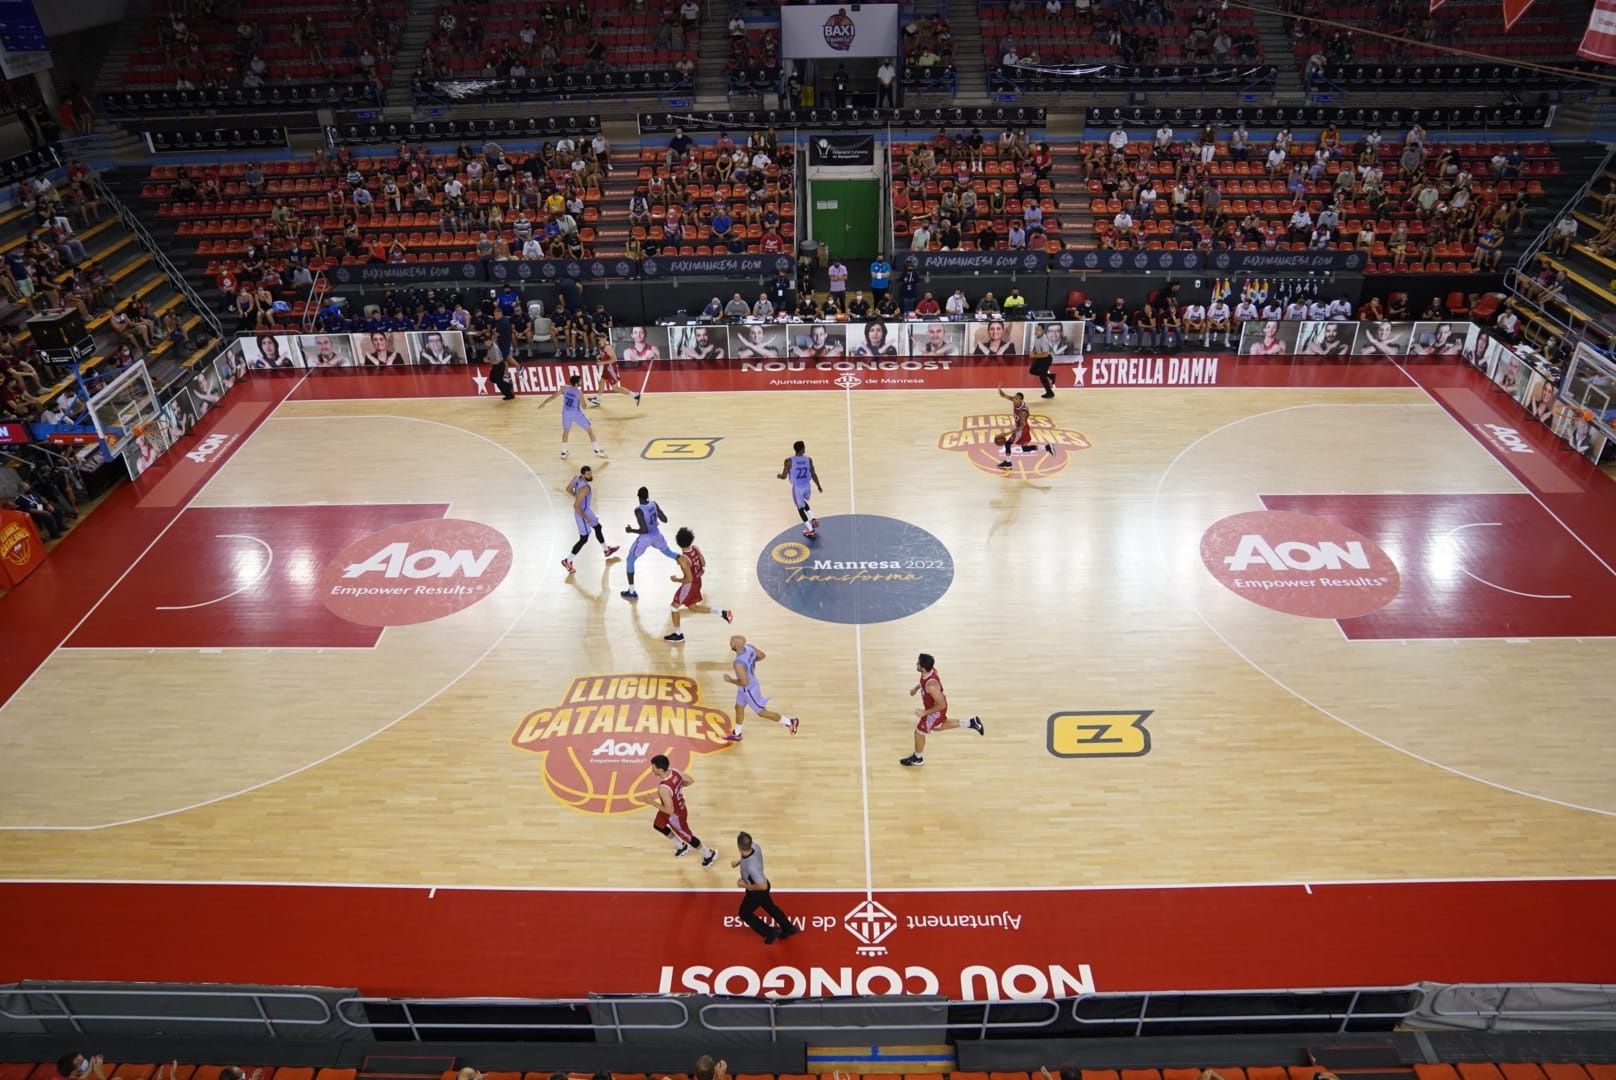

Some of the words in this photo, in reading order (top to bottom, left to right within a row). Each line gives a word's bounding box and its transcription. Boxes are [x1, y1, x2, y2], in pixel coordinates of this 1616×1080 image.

[825, 25, 854, 36] BAXI
[741, 361, 806, 372] NOU
[815, 360, 953, 371] CONGOST
[1091, 358, 1164, 385] ESTRELLA
[1167, 357, 1219, 385] DAMM
[494, 365, 566, 393] TRELLA
[769, 378, 830, 386] Ajuntament
[795, 467, 808, 479] 22
[341, 542, 499, 579] AON
[1223, 534, 1371, 572] AON
[813, 559, 902, 570] Manresa
[904, 560, 945, 569] 2022
[784, 566, 924, 585] Transforma
[1234, 578, 1316, 590] Empower
[330, 585, 411, 597] Empower
[568, 676, 694, 703] LLIGUES
[517, 704, 730, 745] CATALANES
[591, 738, 650, 756] AON
[811, 915, 837, 929] de
[906, 911, 1022, 930] Ajuntament
[960, 964, 1097, 1001] NOU
